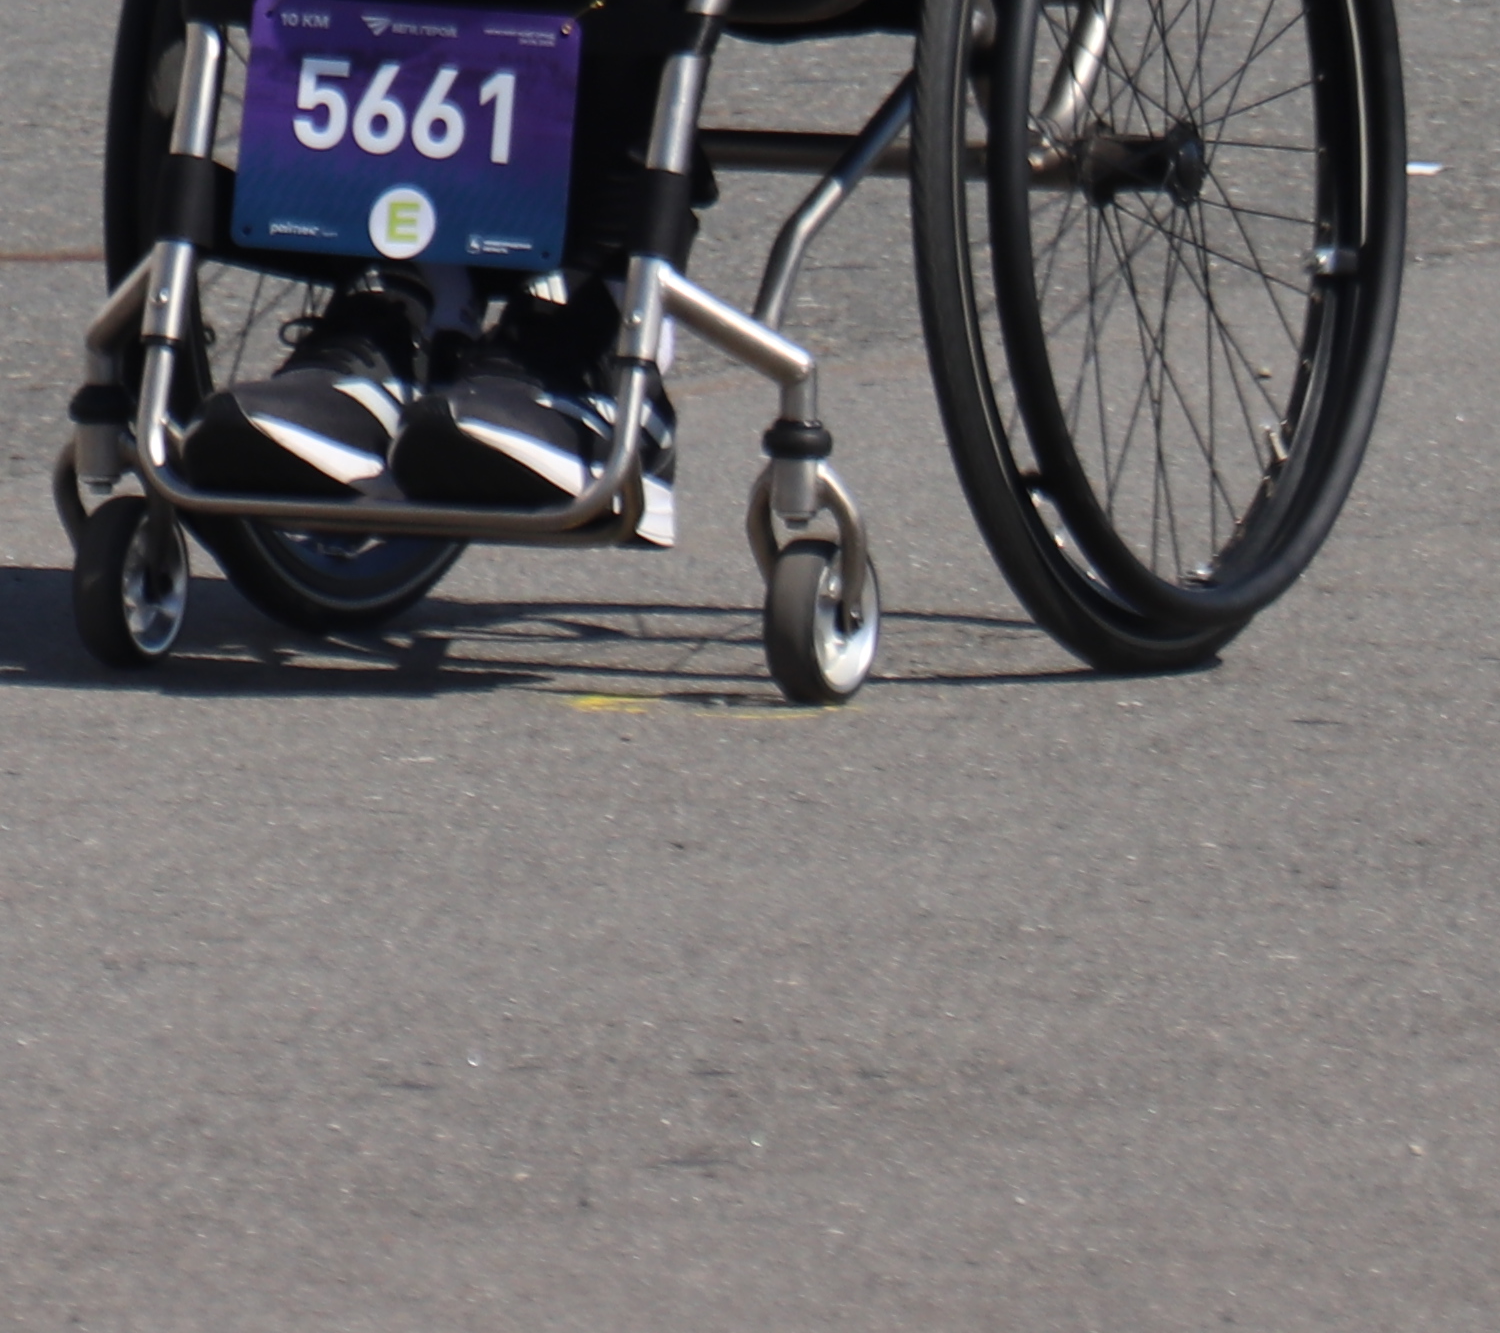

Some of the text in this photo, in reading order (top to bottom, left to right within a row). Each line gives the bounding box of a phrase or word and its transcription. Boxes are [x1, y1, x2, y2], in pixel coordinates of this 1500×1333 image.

[281, 13, 298, 27] 10
[293, 58, 516, 165] 5661
[386, 201, 421, 243] E
